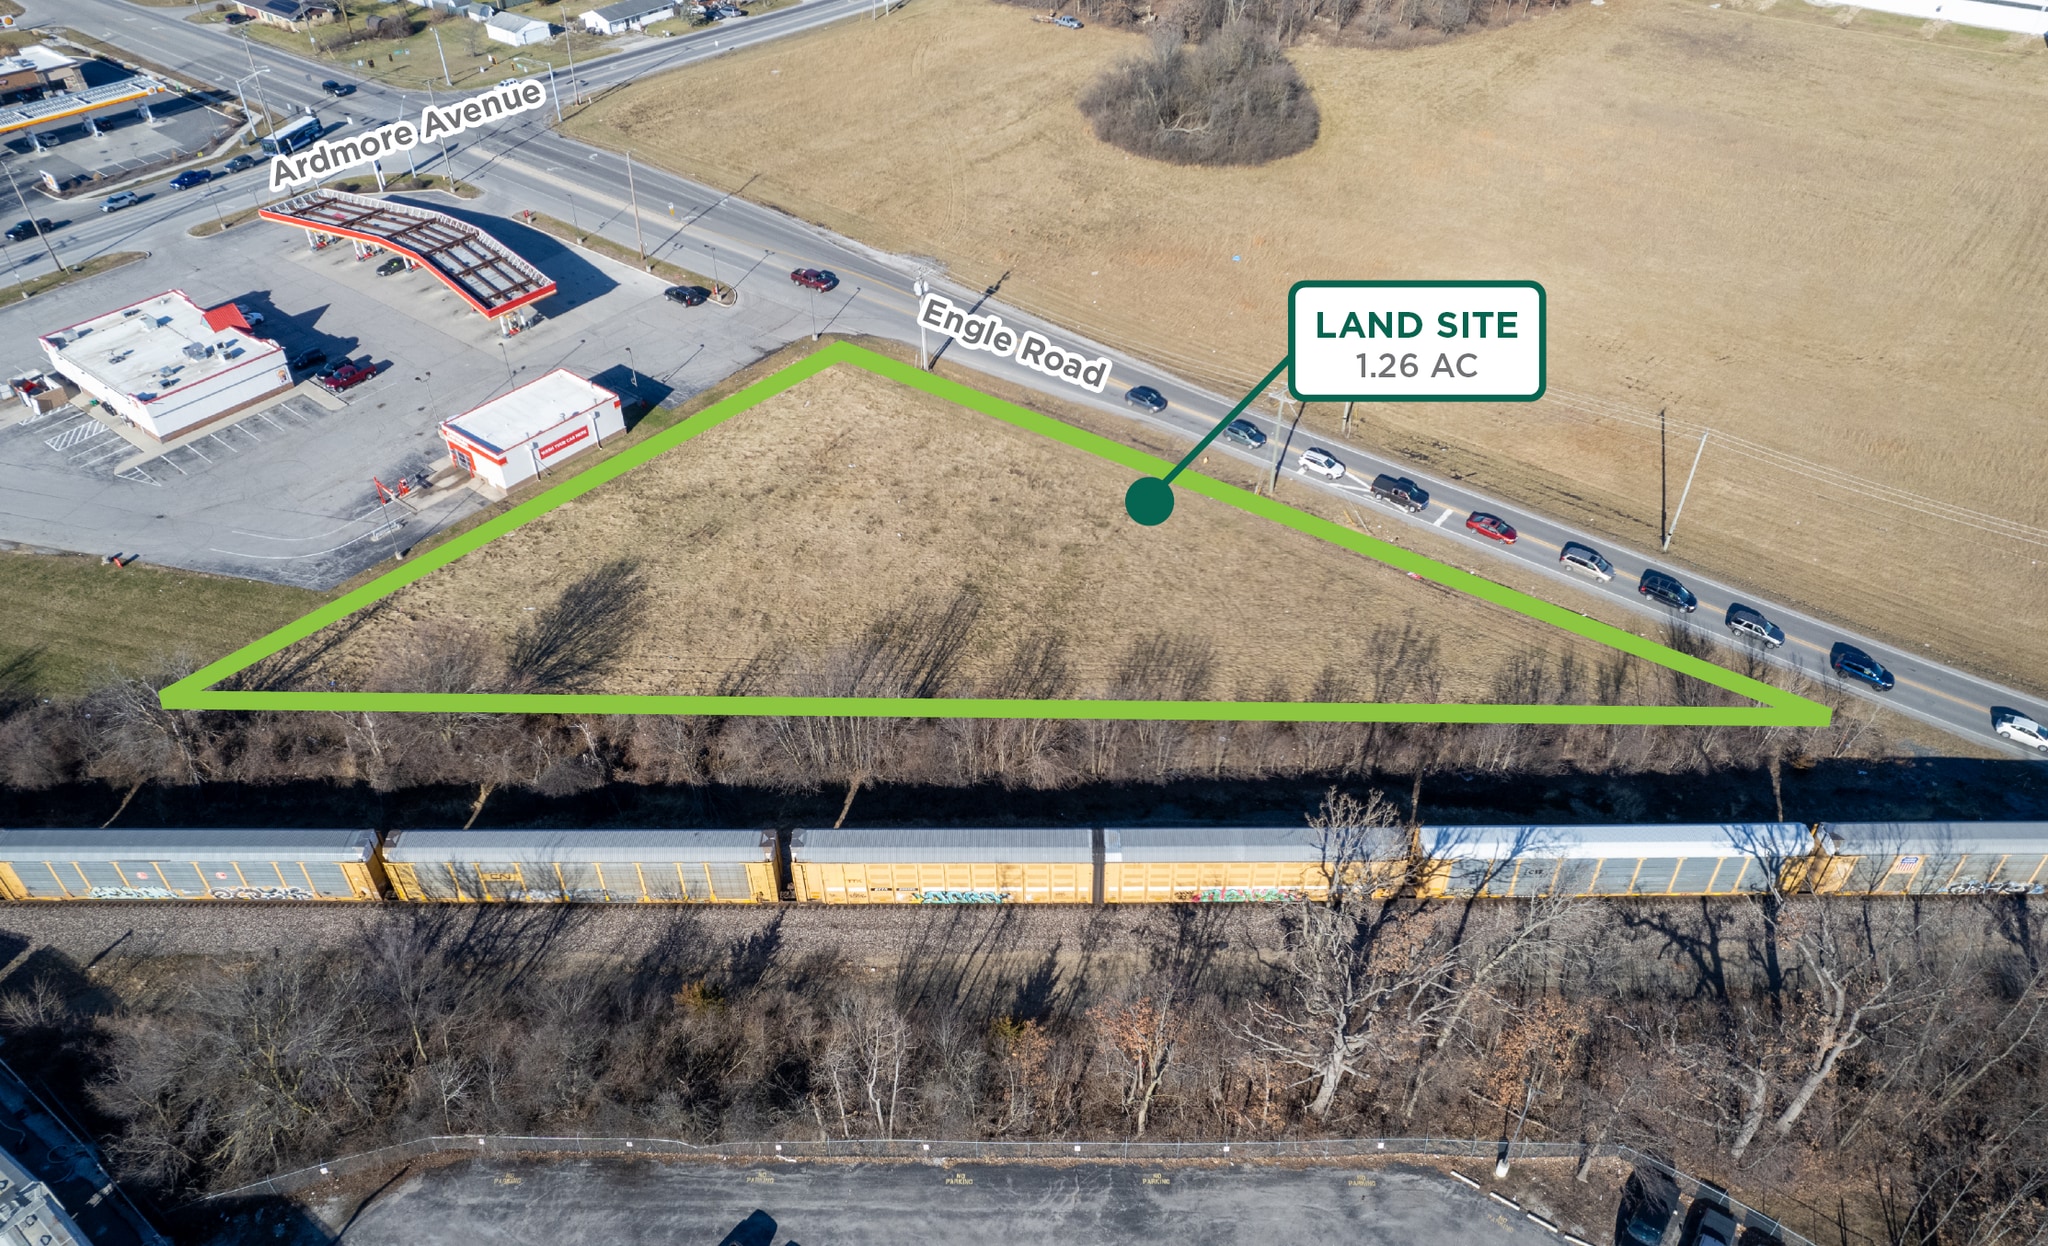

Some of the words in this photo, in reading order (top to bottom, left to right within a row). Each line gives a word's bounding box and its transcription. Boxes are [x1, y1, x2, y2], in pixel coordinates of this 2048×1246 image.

[554, 440, 566, 450] YOUR
[566, 435, 576, 443] CAR
[575, 429, 587, 439] HERE
